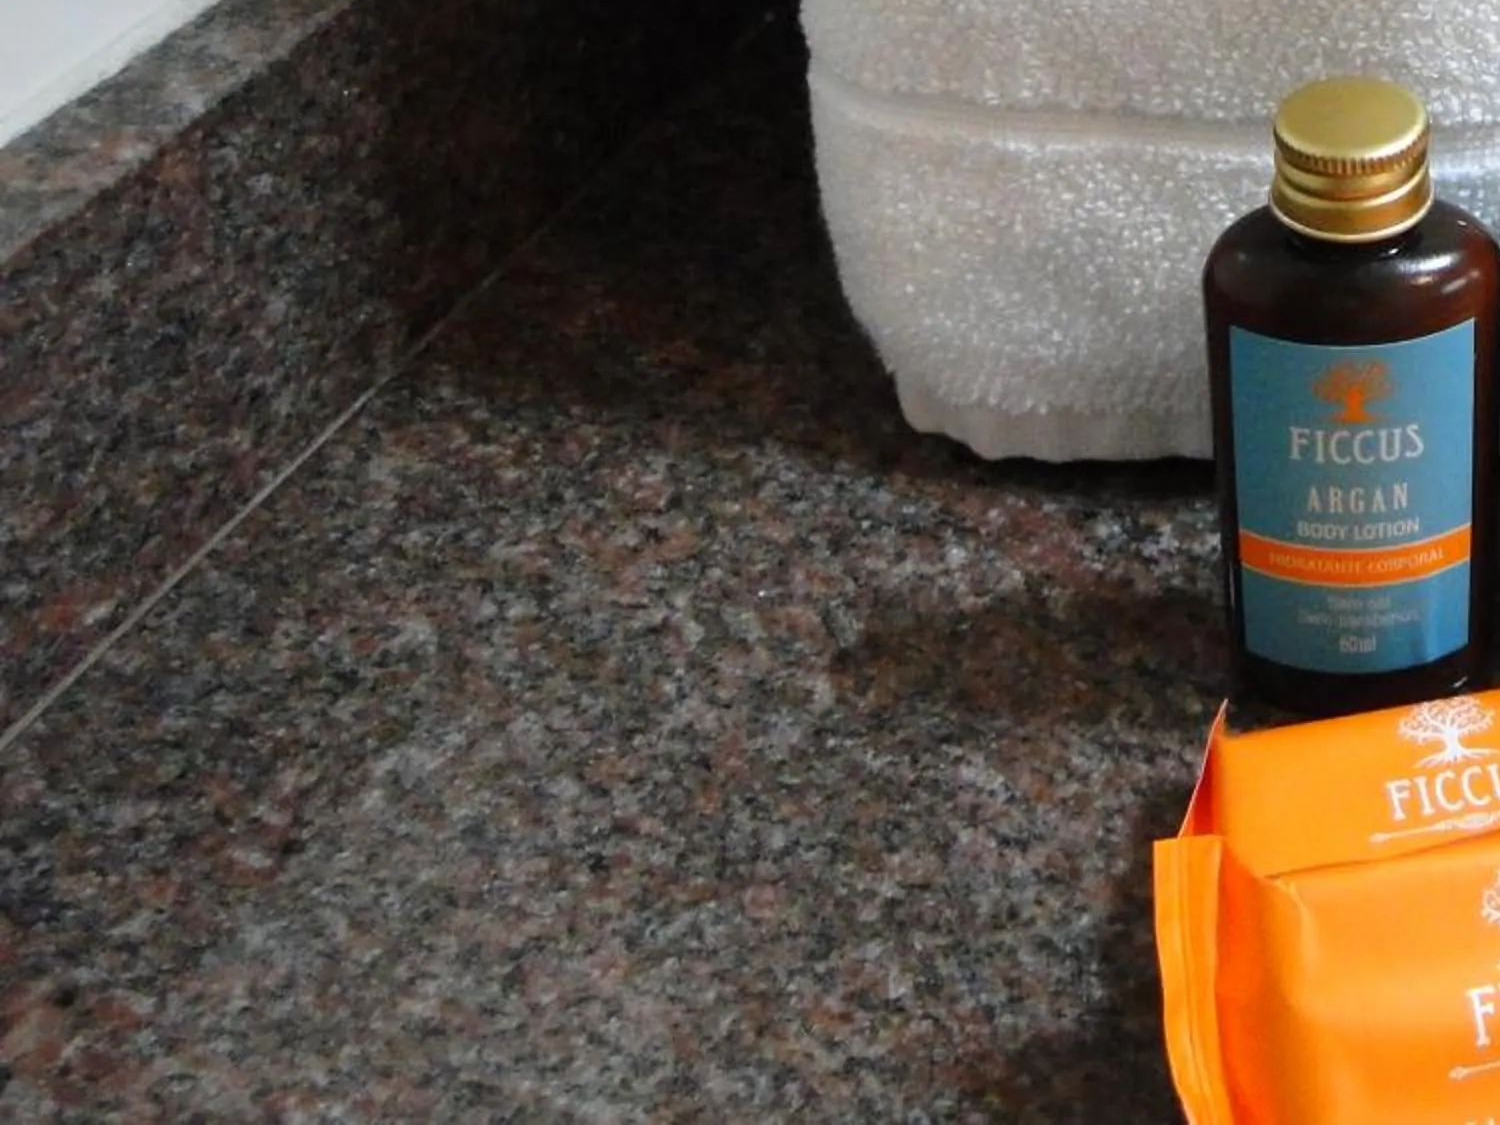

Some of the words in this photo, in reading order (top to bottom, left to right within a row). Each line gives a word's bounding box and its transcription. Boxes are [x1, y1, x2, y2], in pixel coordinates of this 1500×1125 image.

[1289, 423, 1425, 465] FICCUS
[1307, 482, 1409, 514] ARGAN
[1297, 520, 1347, 541] BODY
[1353, 517, 1420, 540] LOTION
